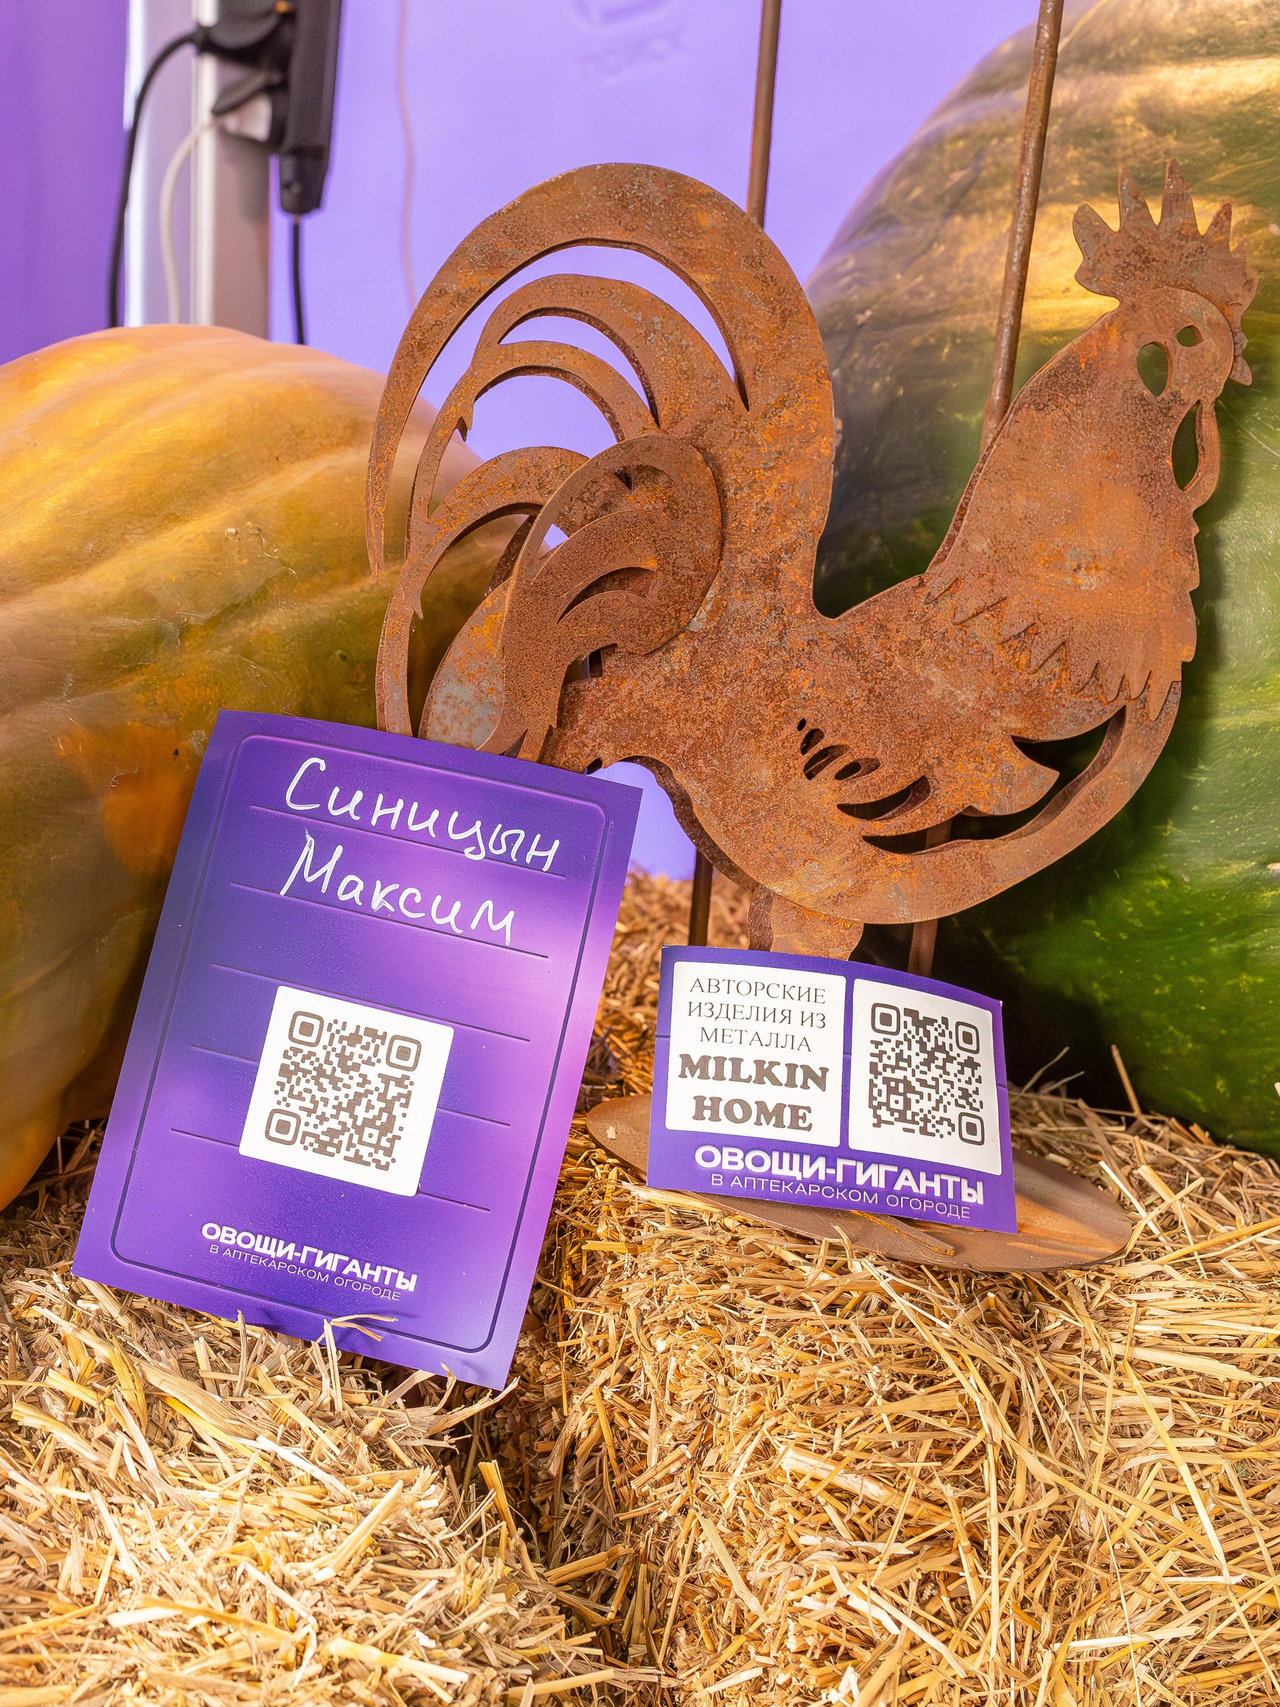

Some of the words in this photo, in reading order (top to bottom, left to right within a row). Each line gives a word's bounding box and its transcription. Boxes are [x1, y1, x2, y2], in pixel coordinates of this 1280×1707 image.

[284, 757, 560, 872] Синицын
[279, 827, 516, 946] Максим
[689, 976, 827, 1005] АВТОРСКИЕ
[687, 1001, 793, 1026] ИЗДЕЛИЯ
[800, 1010, 827, 1030] ИЗ
[699, 1026, 813, 1053] МЕТАЛЛА
[678, 1053, 830, 1093] MILKIN
[692, 1095, 813, 1132] HOME
[694, 1145, 985, 1206] ОВОЩИ-ГИГАНТЫ
[710, 1173, 724, 1187] В
[729, 1174, 879, 1206] АПТЕКАРСКОМ
[885, 1194, 972, 1220] ОГОРОДЕ
[200, 1222, 419, 1292] ОВОЩИ-ГИГАНТЫ
[209, 1243, 220, 1254] В
[222, 1247, 331, 1284] АПТЕКАРСКОМ
[333, 1276, 402, 1302] ОГОРОДЕ
